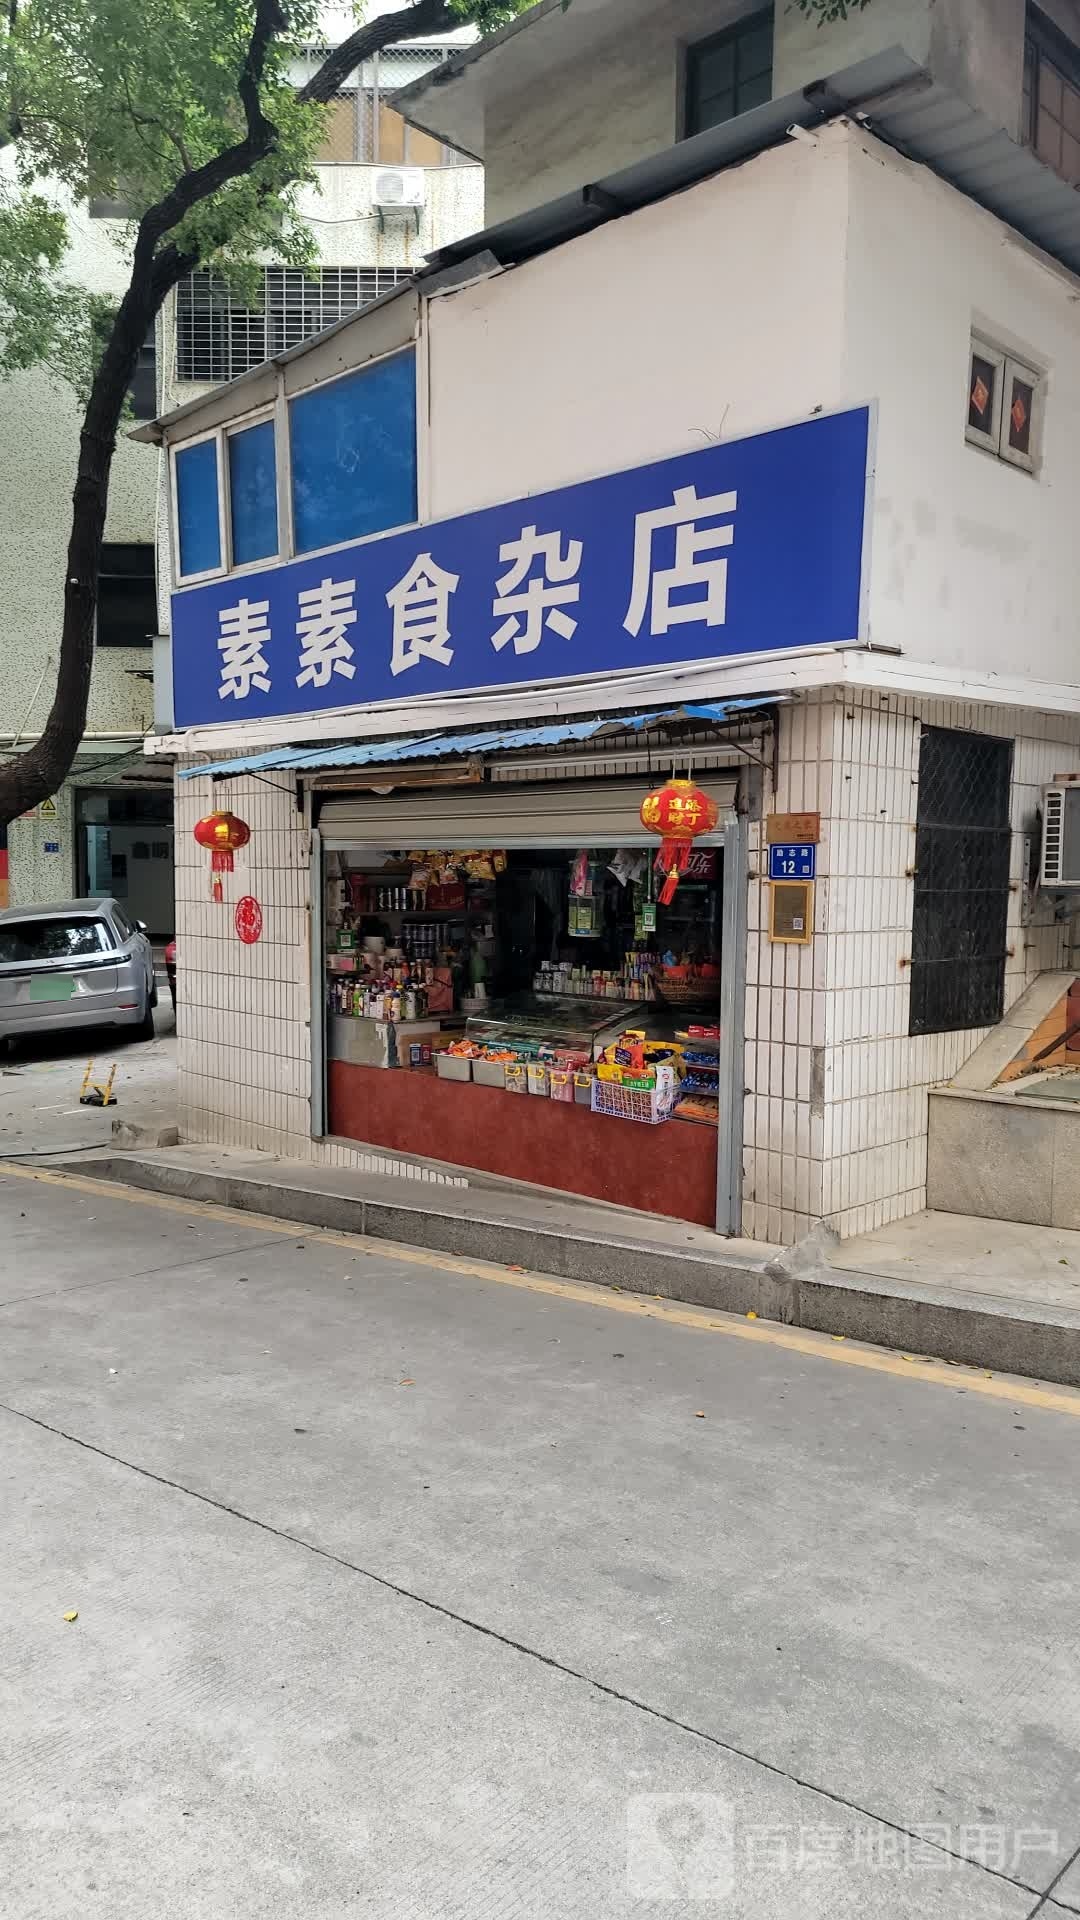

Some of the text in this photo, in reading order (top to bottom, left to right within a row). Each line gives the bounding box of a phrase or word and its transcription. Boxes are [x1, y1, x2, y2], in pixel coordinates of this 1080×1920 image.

[217, 485, 738, 700] 素素食杂店
[781, 860, 796, 874] 12
